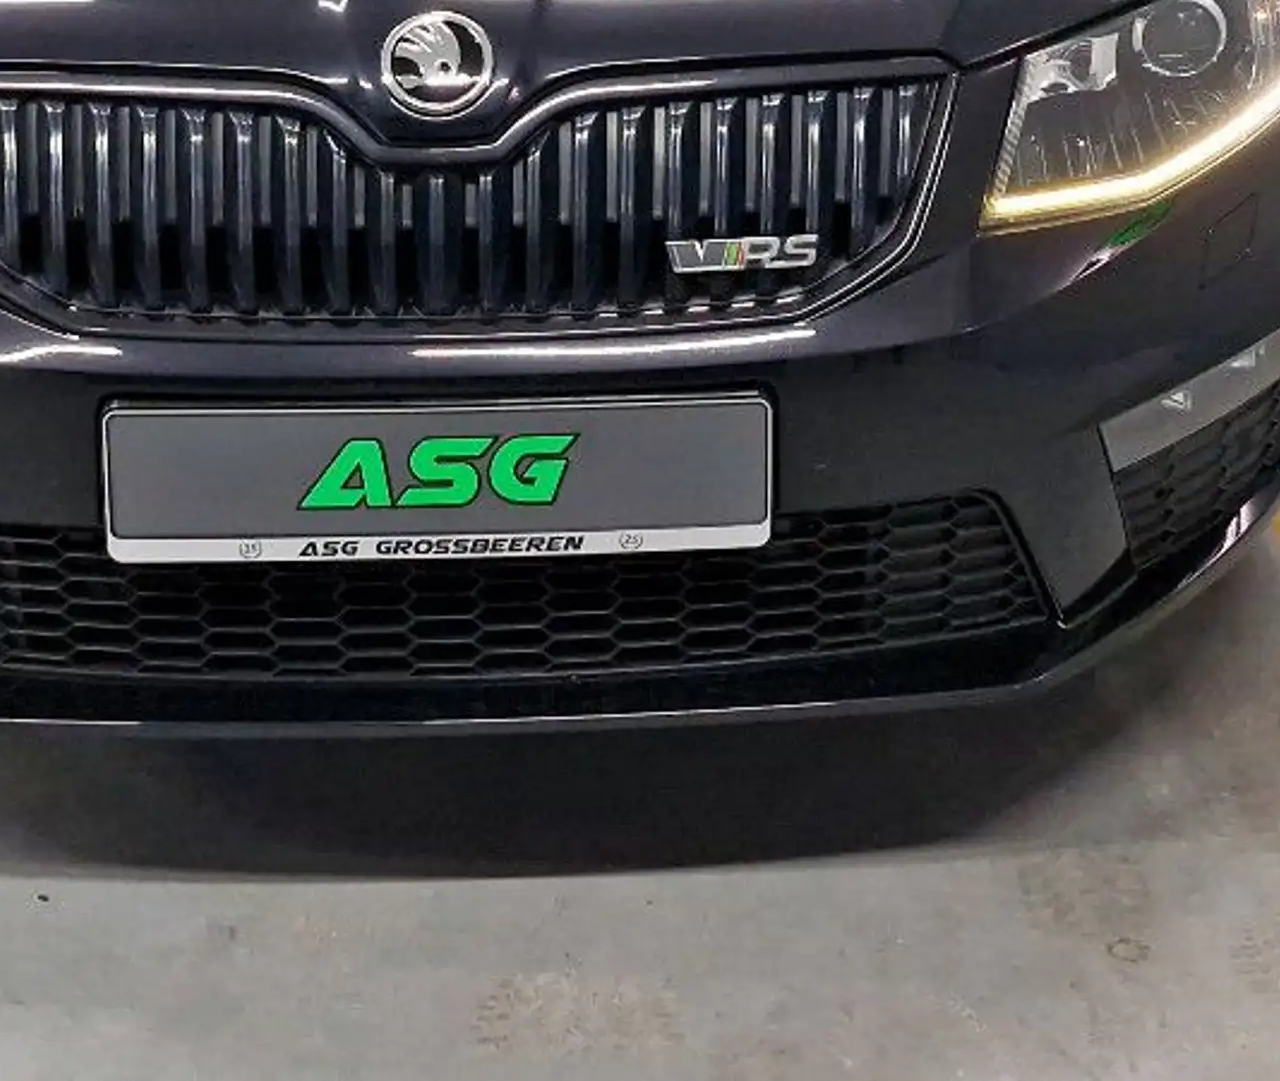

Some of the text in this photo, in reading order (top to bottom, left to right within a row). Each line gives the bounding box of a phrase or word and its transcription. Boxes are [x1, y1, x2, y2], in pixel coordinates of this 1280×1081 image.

[296, 433, 580, 510] ASG
[299, 541, 361, 556] ASG
[375, 535, 584, 555] GROSSBEEREN
